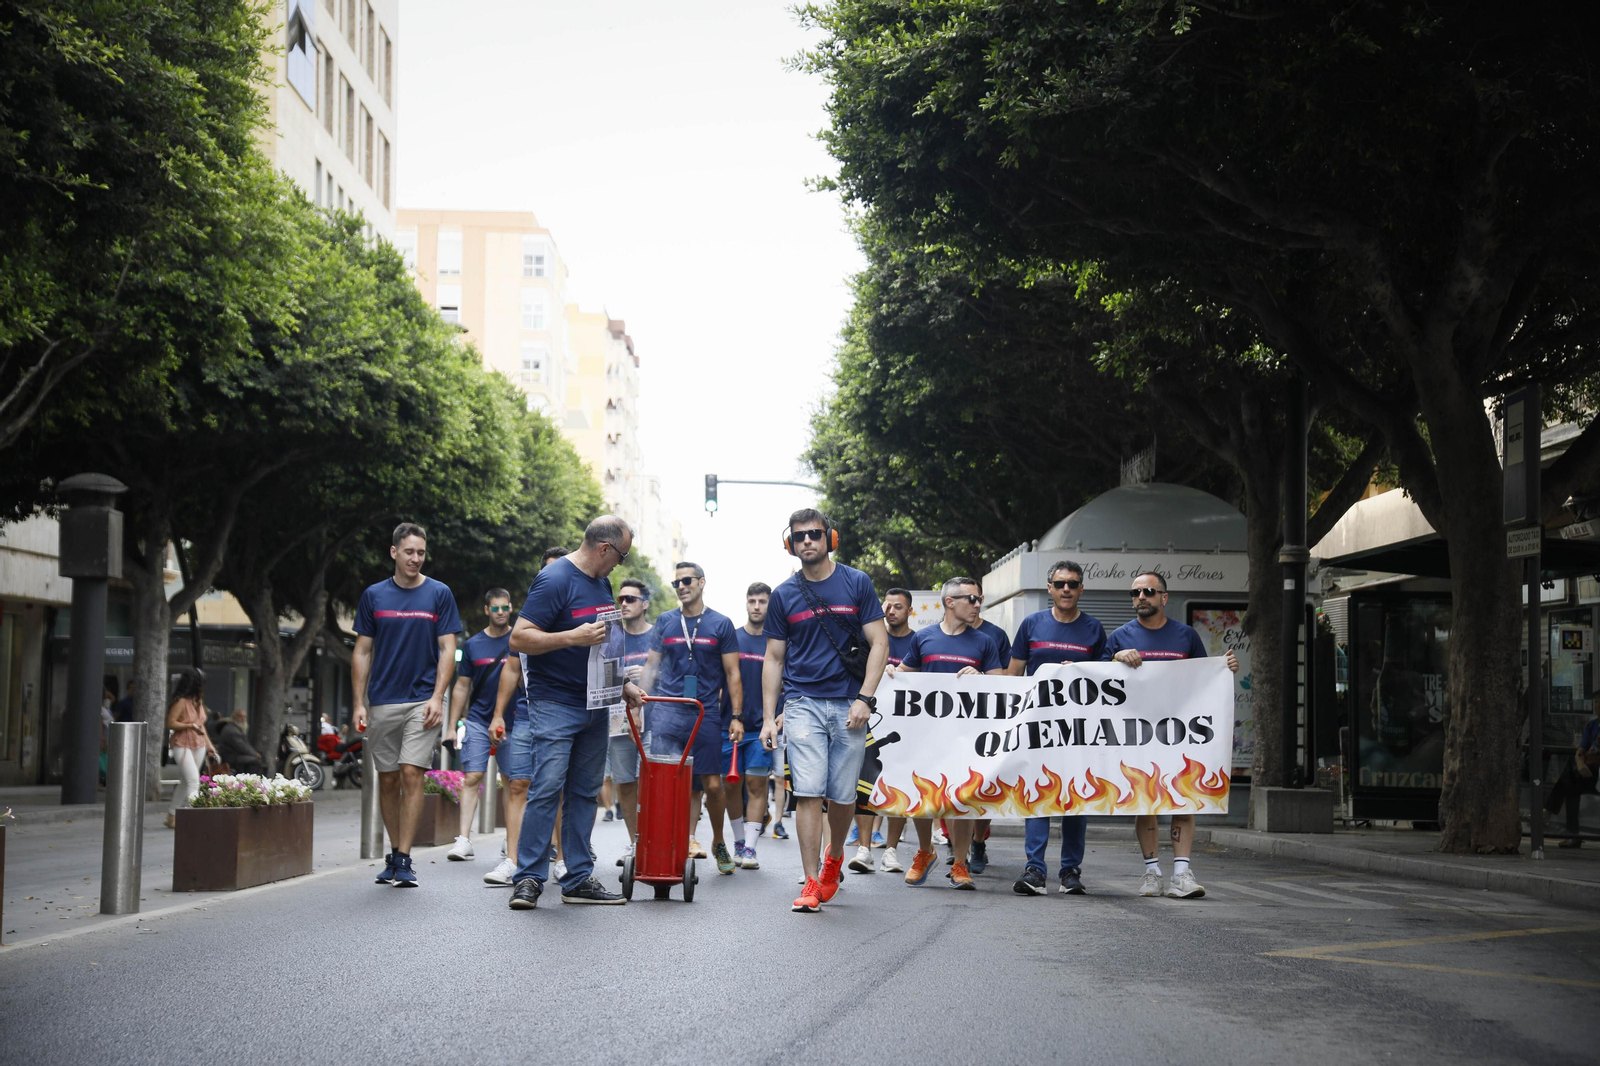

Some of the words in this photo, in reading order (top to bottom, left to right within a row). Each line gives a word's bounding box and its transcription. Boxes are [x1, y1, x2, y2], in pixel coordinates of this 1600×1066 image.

[1079, 562, 1126, 580] Kiosko
[1177, 565, 1225, 580] Flores
[892, 677, 1127, 719] BOMBEROS
[974, 715, 1215, 758] QUEMADOS
[1359, 765, 1443, 789] Cruzca
